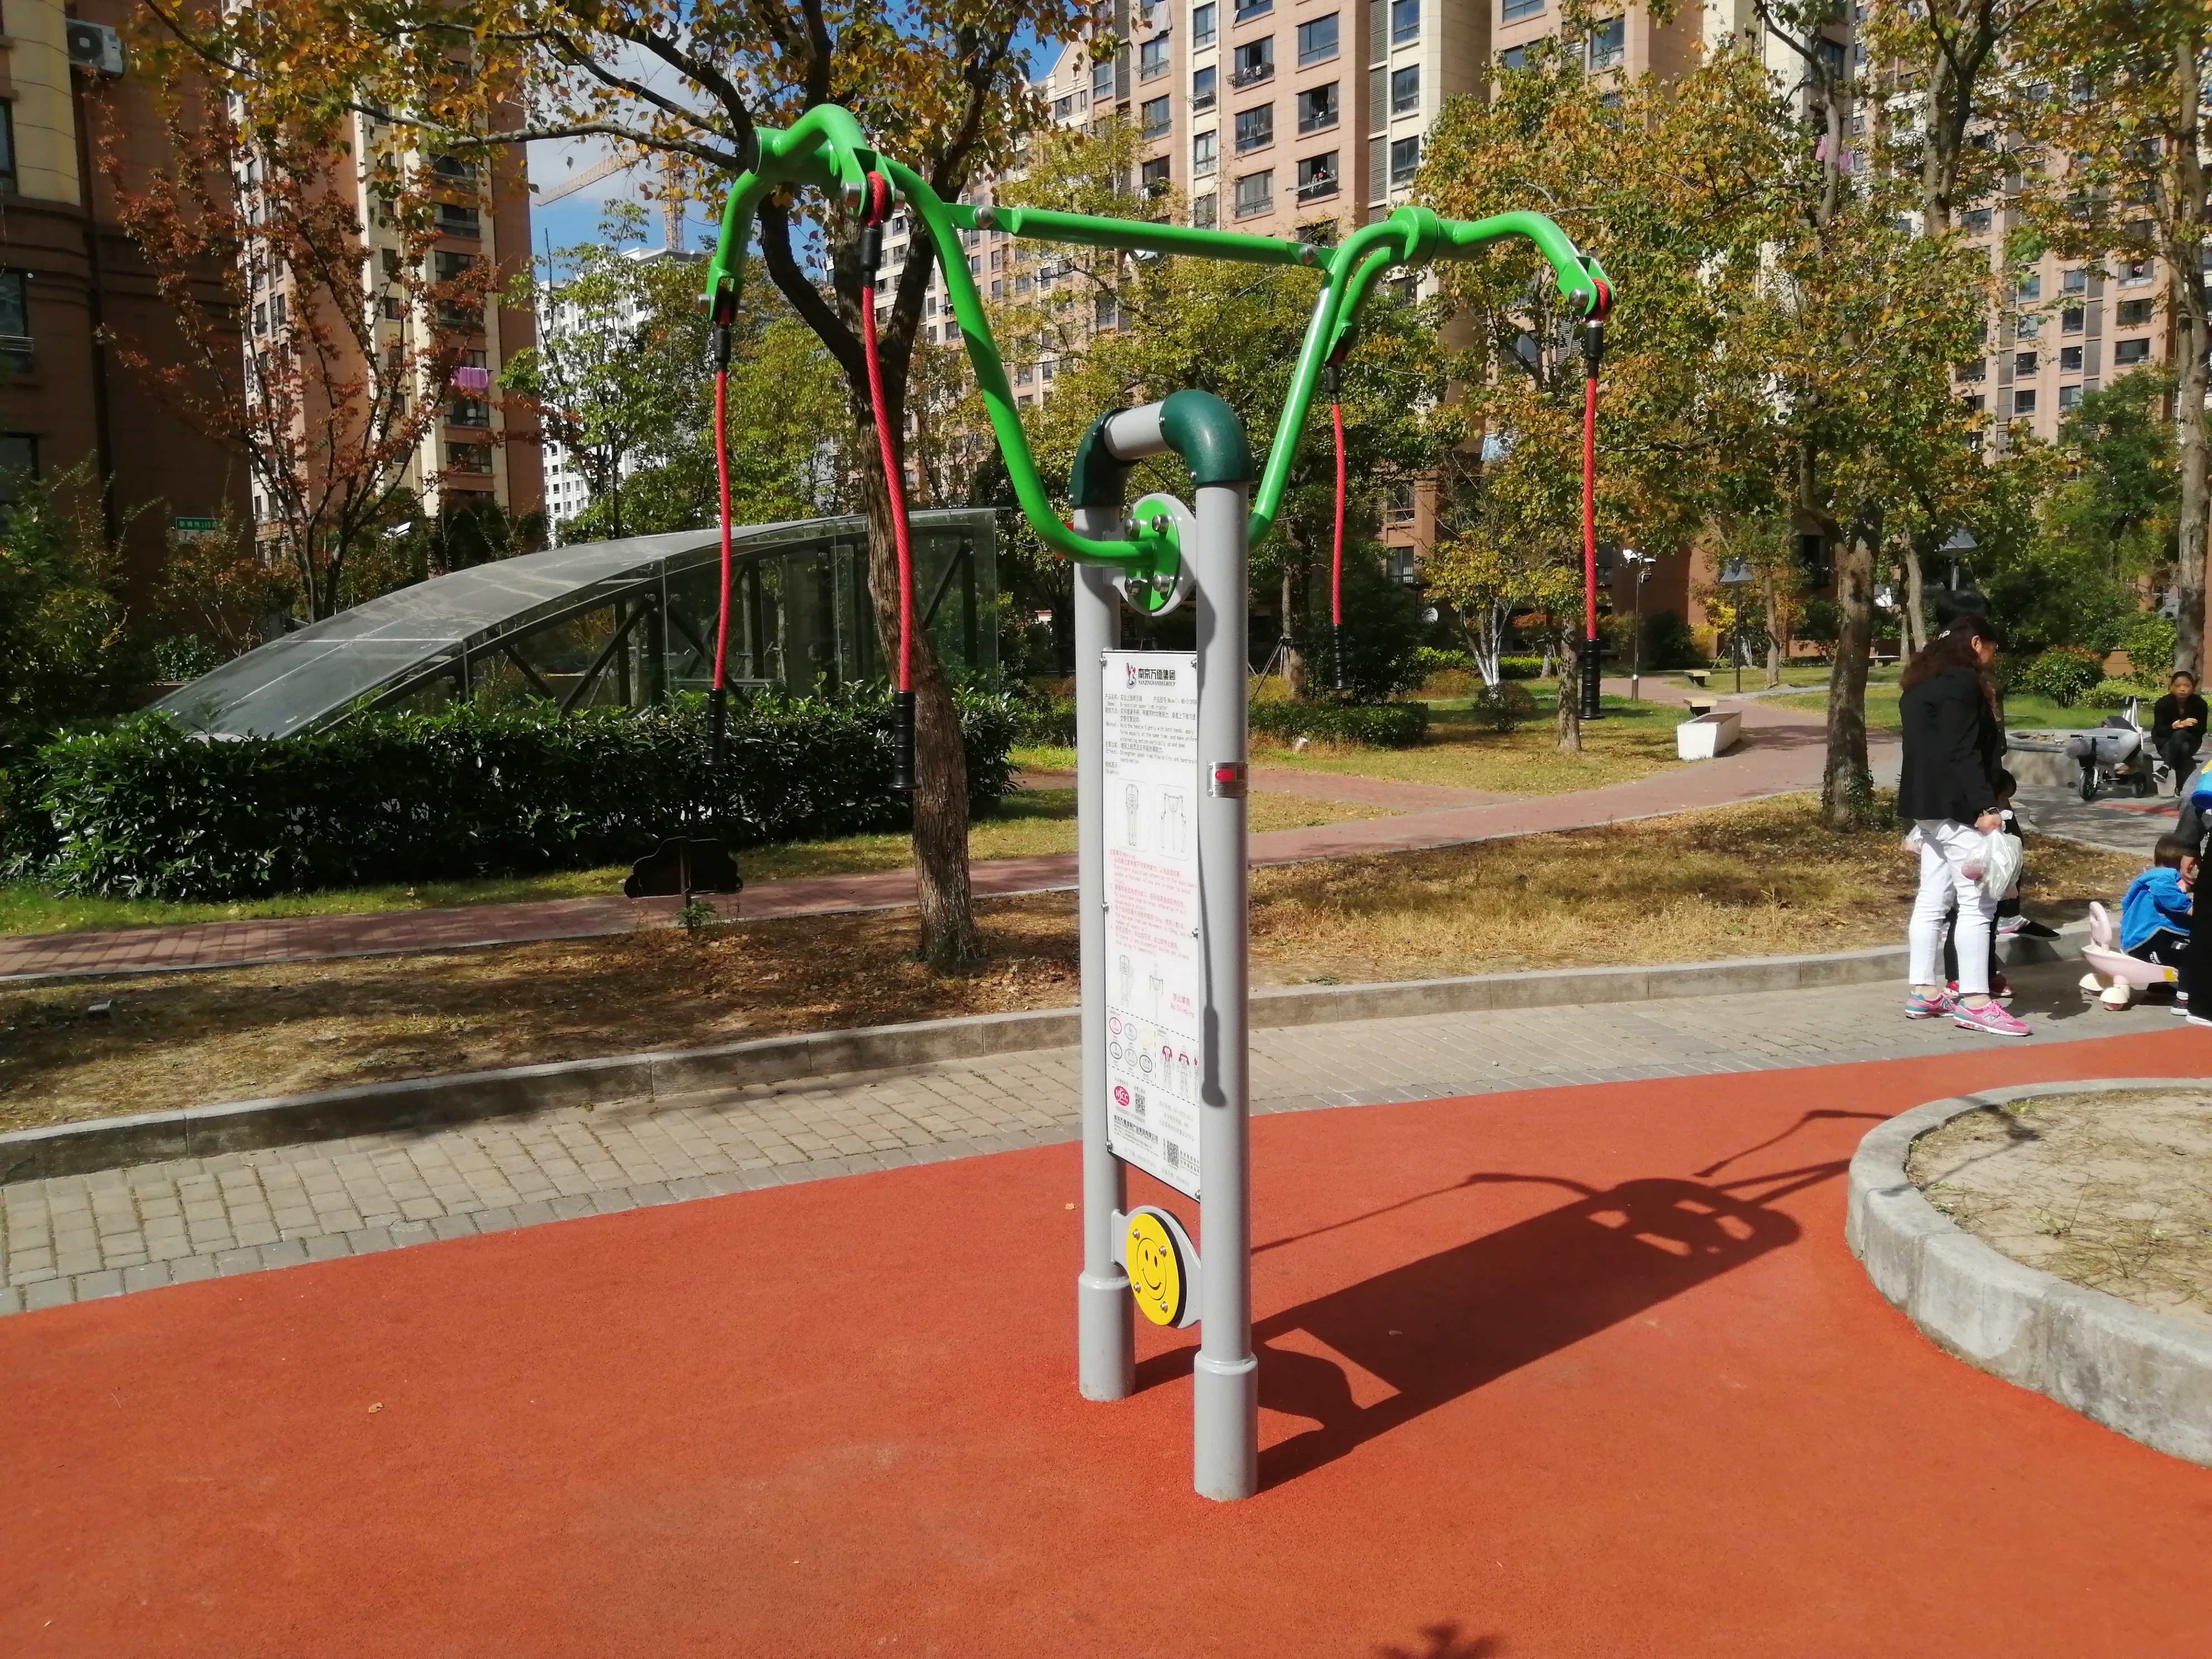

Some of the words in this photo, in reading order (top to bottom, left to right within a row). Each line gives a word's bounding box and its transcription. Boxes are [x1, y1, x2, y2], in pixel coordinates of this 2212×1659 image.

[1138, 668, 1176, 680] 南京万德集团
[1173, 993, 1190, 1006] 禁止攀爬
[1177, 1005, 1195, 1018] Climbing
[1115, 1088, 1129, 1102] NSCC
